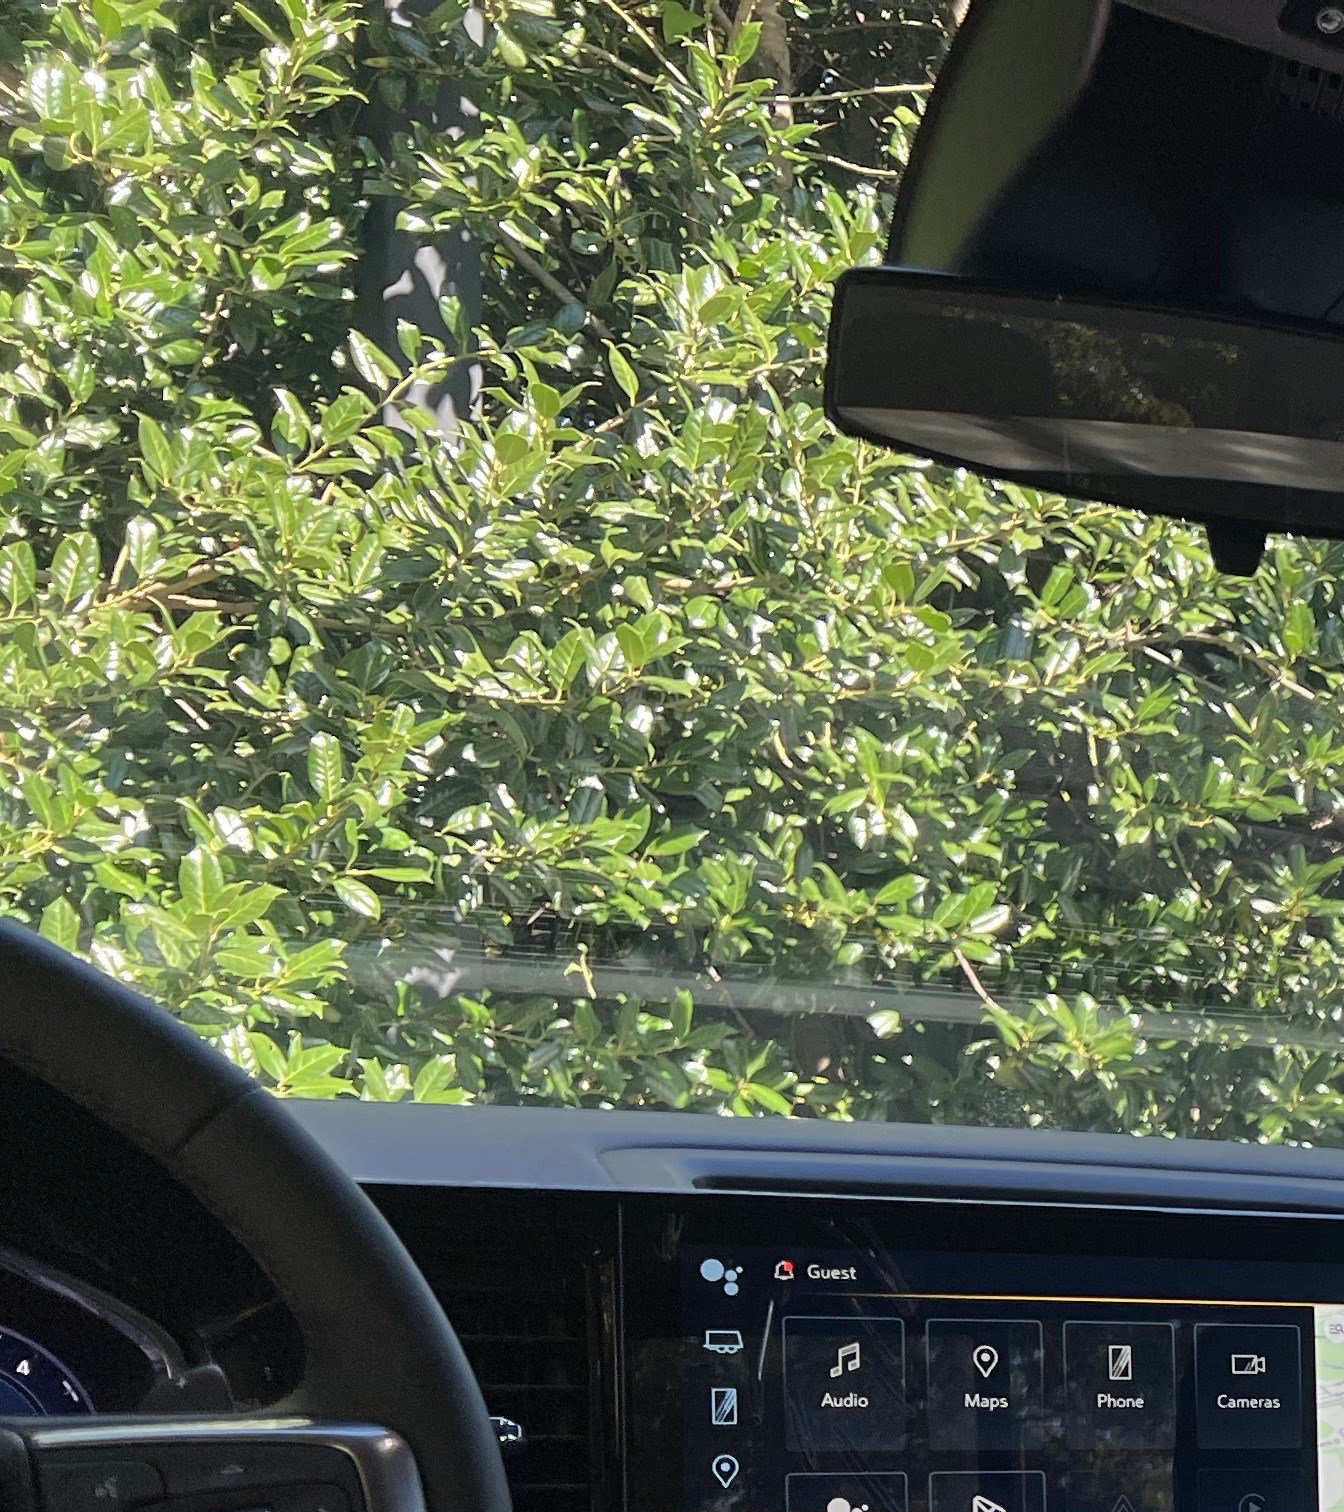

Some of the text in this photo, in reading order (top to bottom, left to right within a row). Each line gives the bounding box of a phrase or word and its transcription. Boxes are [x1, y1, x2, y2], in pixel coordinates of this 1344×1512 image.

[806, 1264, 857, 1281] Guest
[16, 1359, 31, 1376] 4
[820, 1392, 869, 1409] Audio
[964, 1393, 1009, 1412] Maps
[1096, 1393, 1145, 1409] Phone
[1216, 1394, 1281, 1409] Cameras
